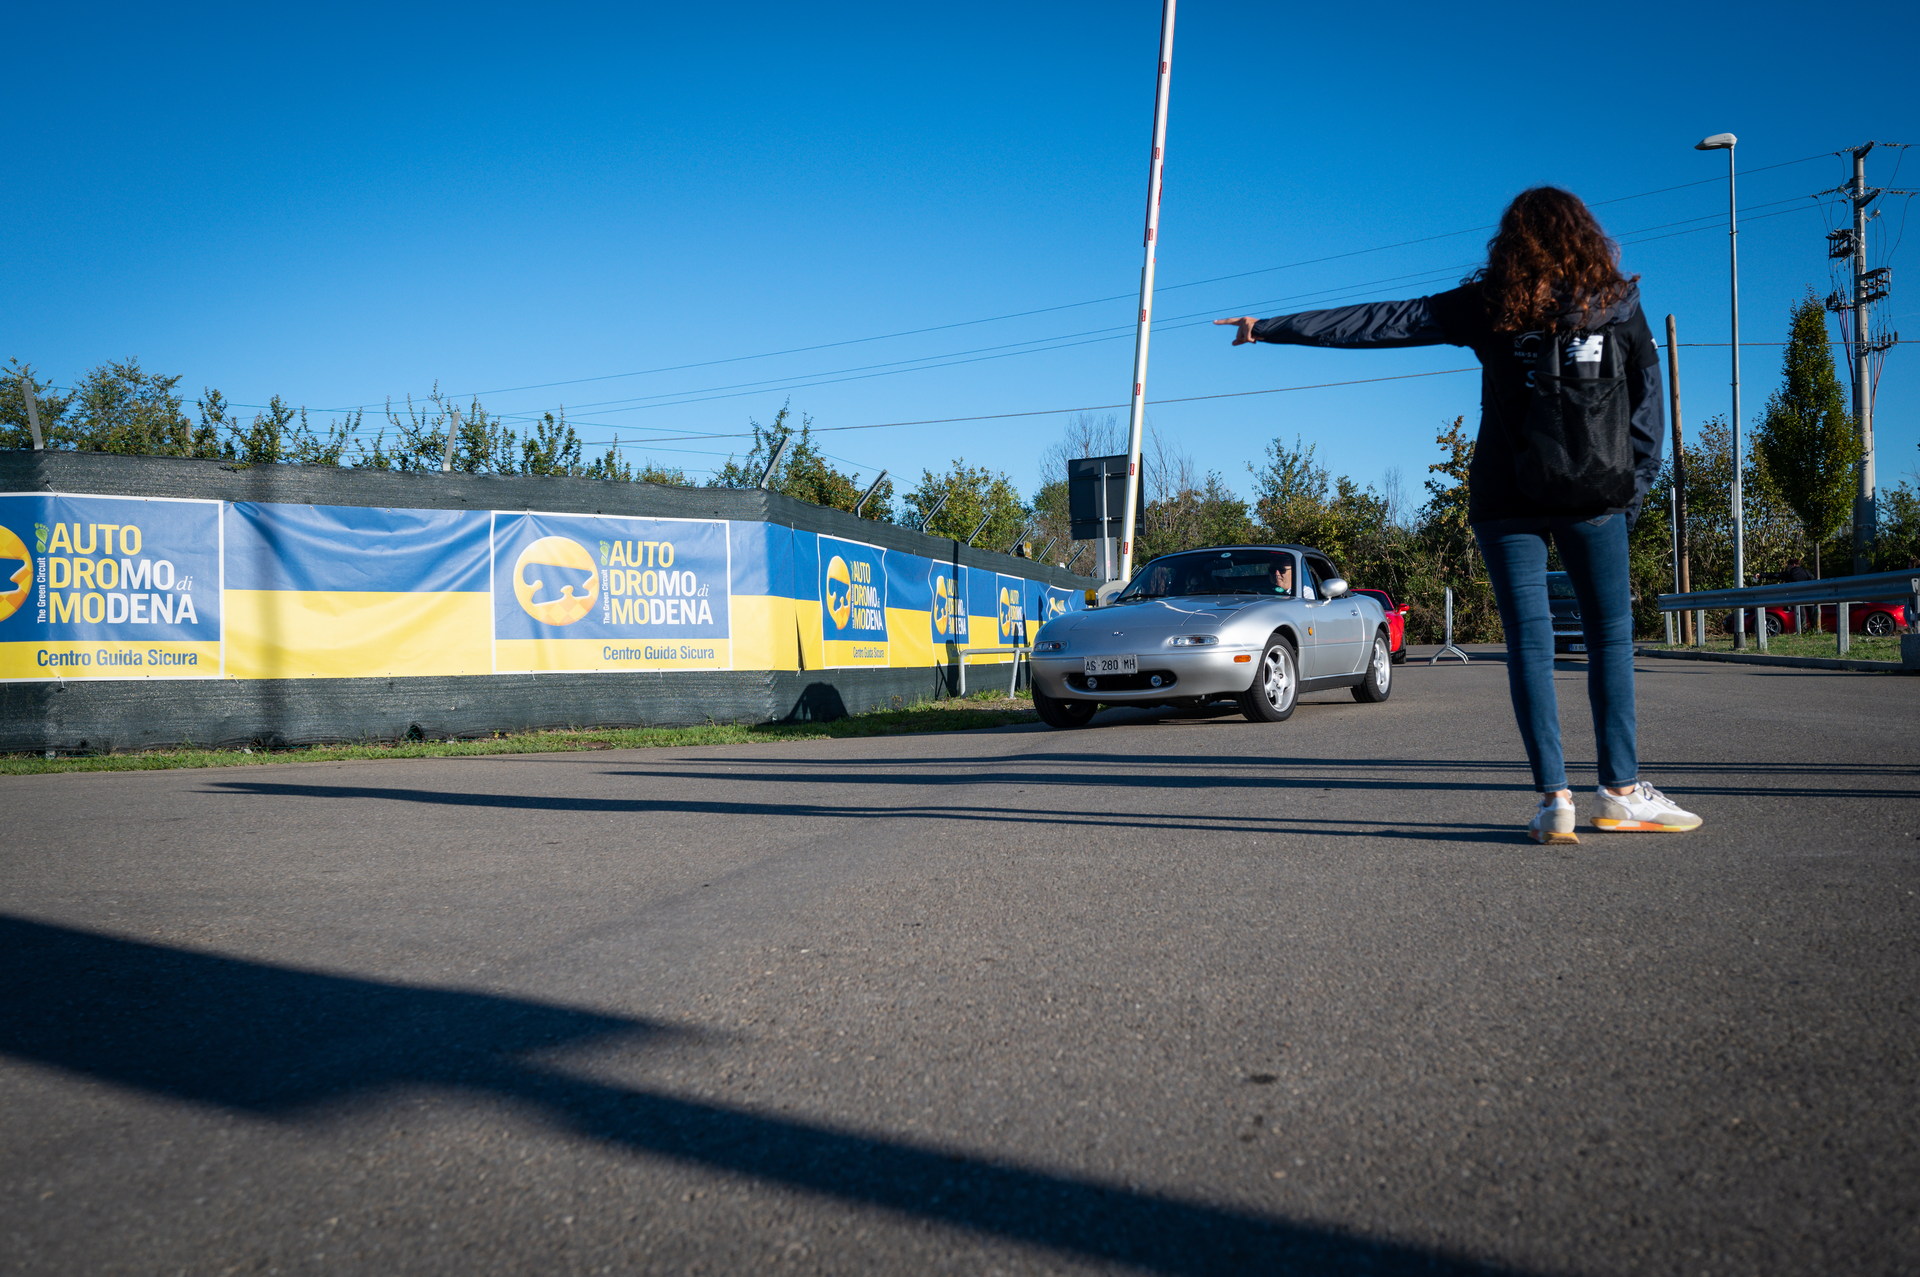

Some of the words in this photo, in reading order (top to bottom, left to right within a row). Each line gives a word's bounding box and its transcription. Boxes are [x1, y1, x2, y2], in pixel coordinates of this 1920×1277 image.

[48, 522, 142, 556] AUTO
[609, 540, 675, 568] AUTO
[36, 557, 46, 583] Circuit
[49, 557, 175, 591] DROMO
[176, 575, 193, 591] di
[853, 561, 871, 584] AUTO
[609, 569, 697, 597] DROMO
[697, 584, 710, 597] di
[36, 584, 46, 608] Green
[853, 584, 877, 608] DROMO
[36, 608, 46, 624] The
[49, 592, 199, 625] MODENA
[611, 598, 714, 625] MODENA
[853, 608, 884, 631] MODENA
[37, 649, 92, 667] Centro
[96, 649, 143, 666] Guida
[147, 649, 198, 666] Sicura
[603, 646, 641, 661] Centro
[644, 645, 677, 660] Guida
[680, 645, 715, 659] Sicura
[1085, 660, 1097, 671] AS
[1101, 659, 1119, 671] 280
